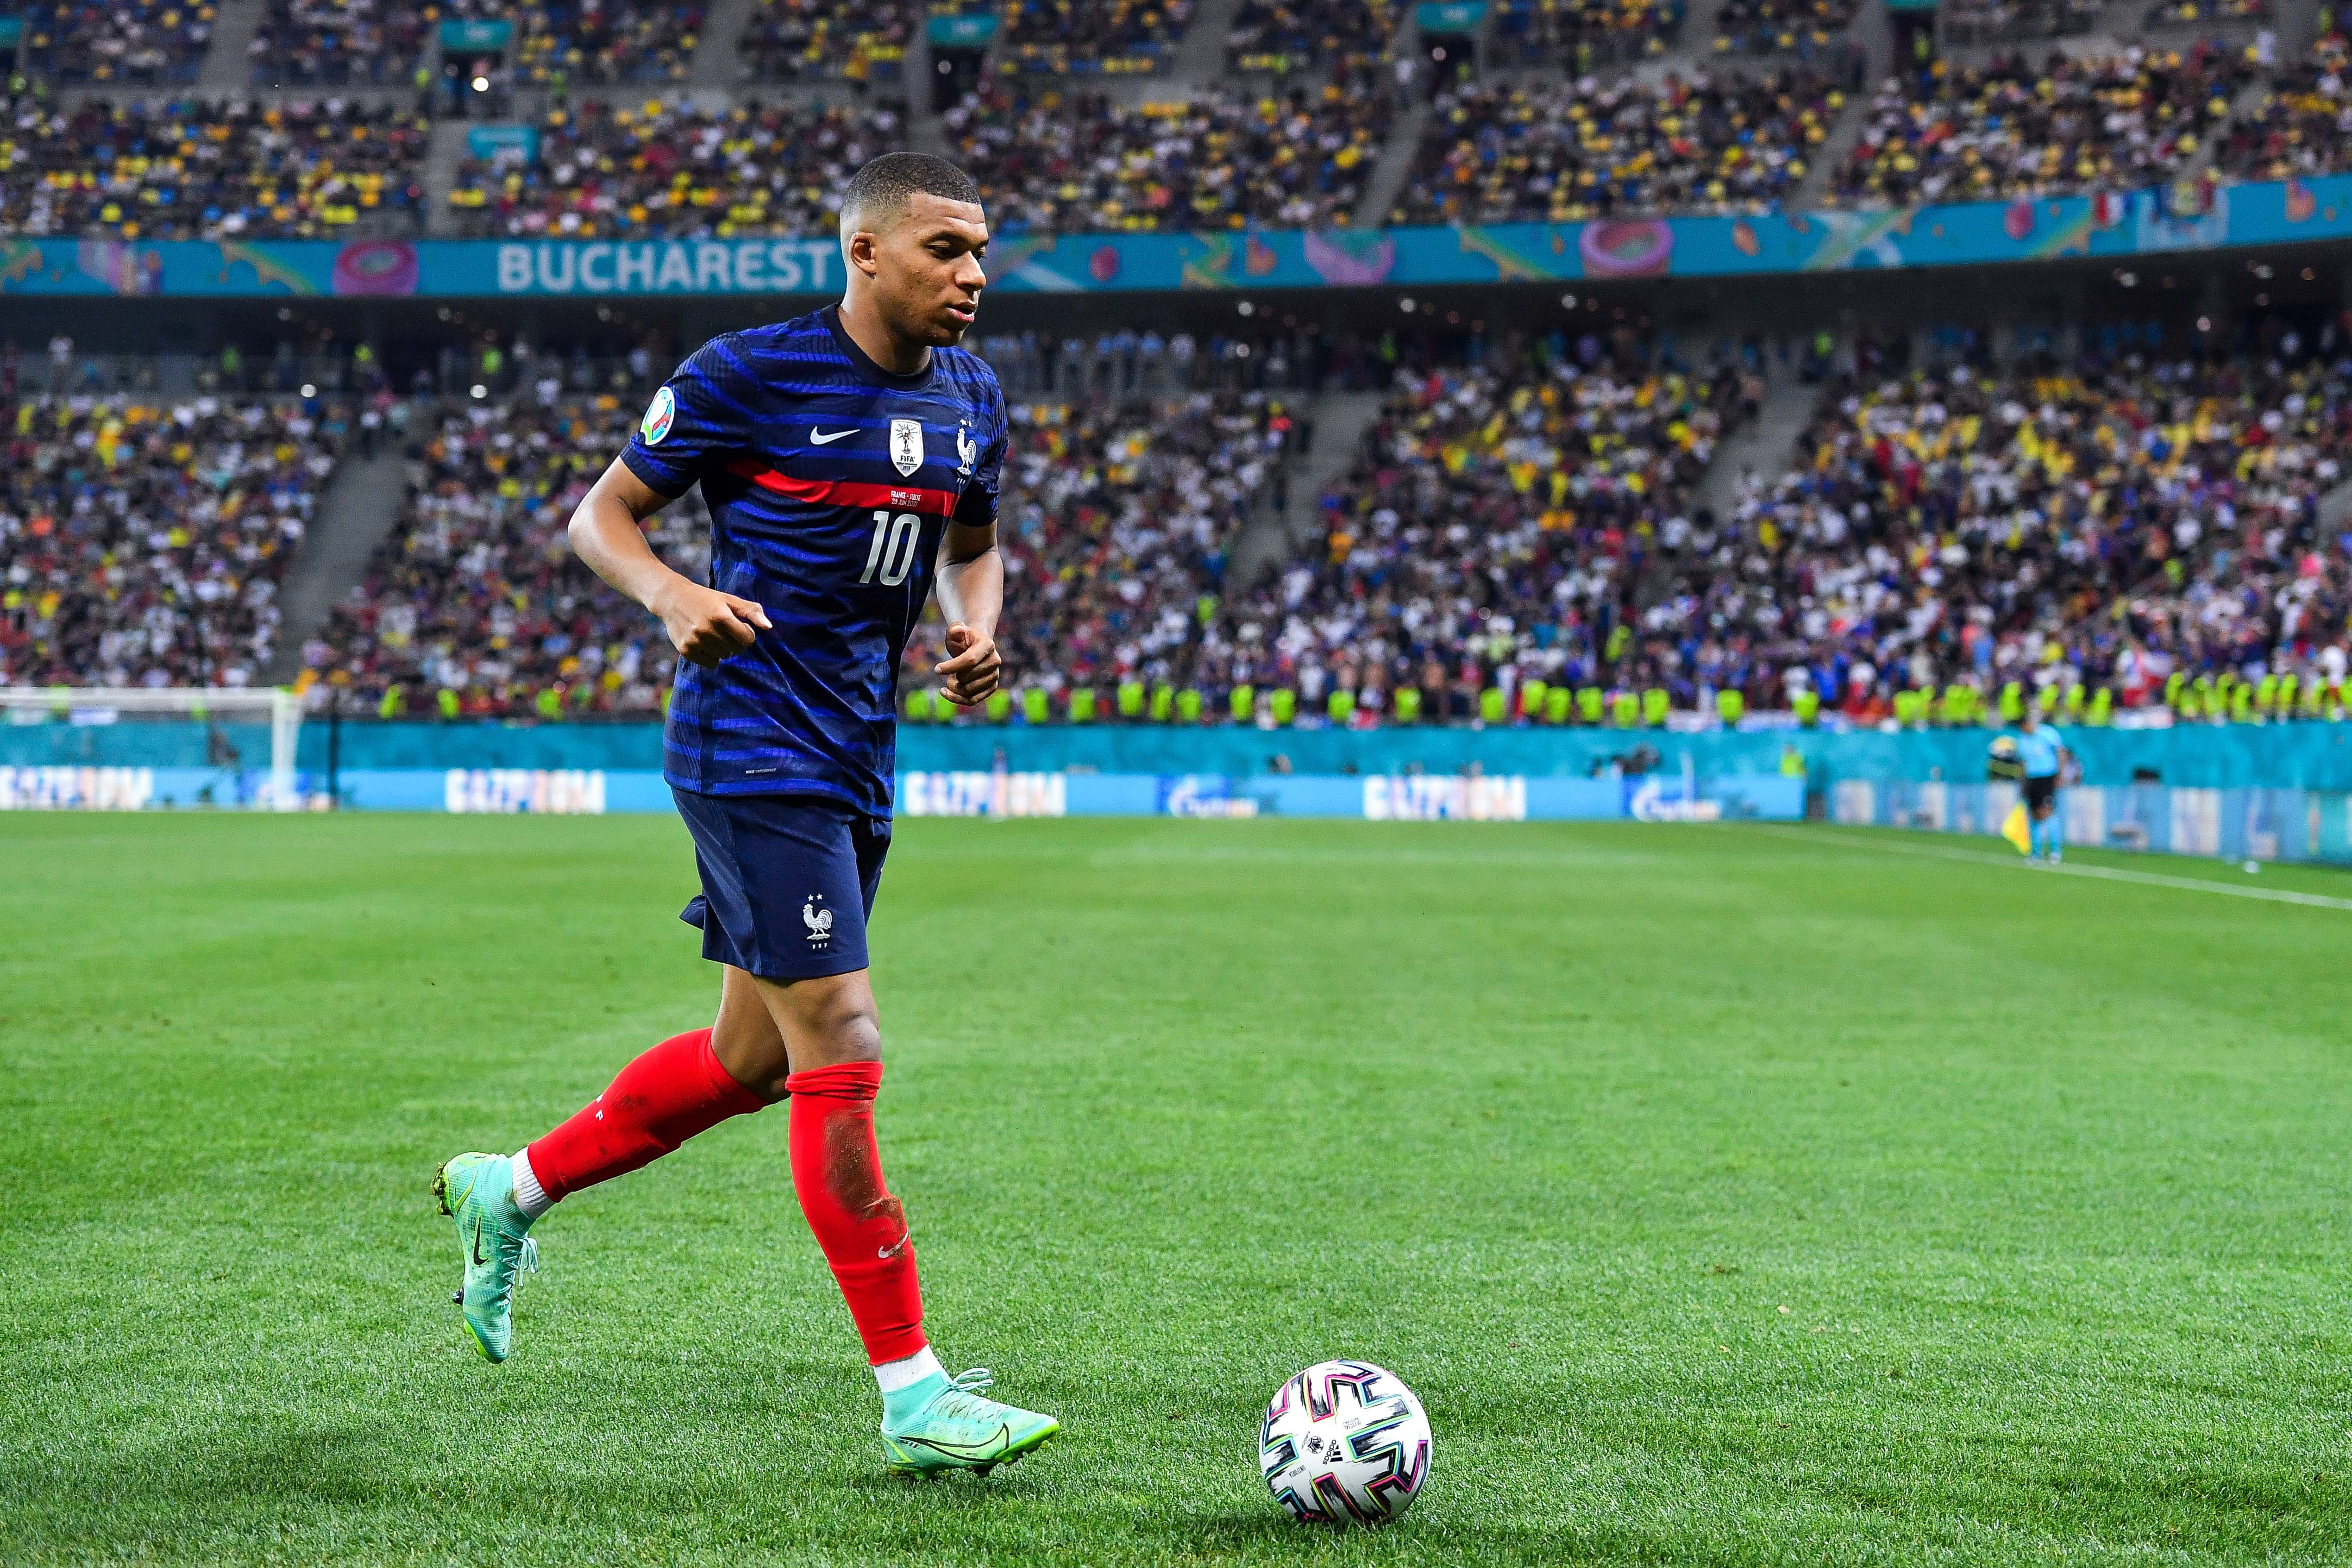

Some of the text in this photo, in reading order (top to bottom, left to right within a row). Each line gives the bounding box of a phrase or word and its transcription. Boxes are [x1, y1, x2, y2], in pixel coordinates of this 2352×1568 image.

[497, 242, 835, 292] BUCHAREST
[891, 490, 906, 499] FRANCE
[859, 511, 921, 586] 10
[1323, 1439, 1336, 1465] adidas
